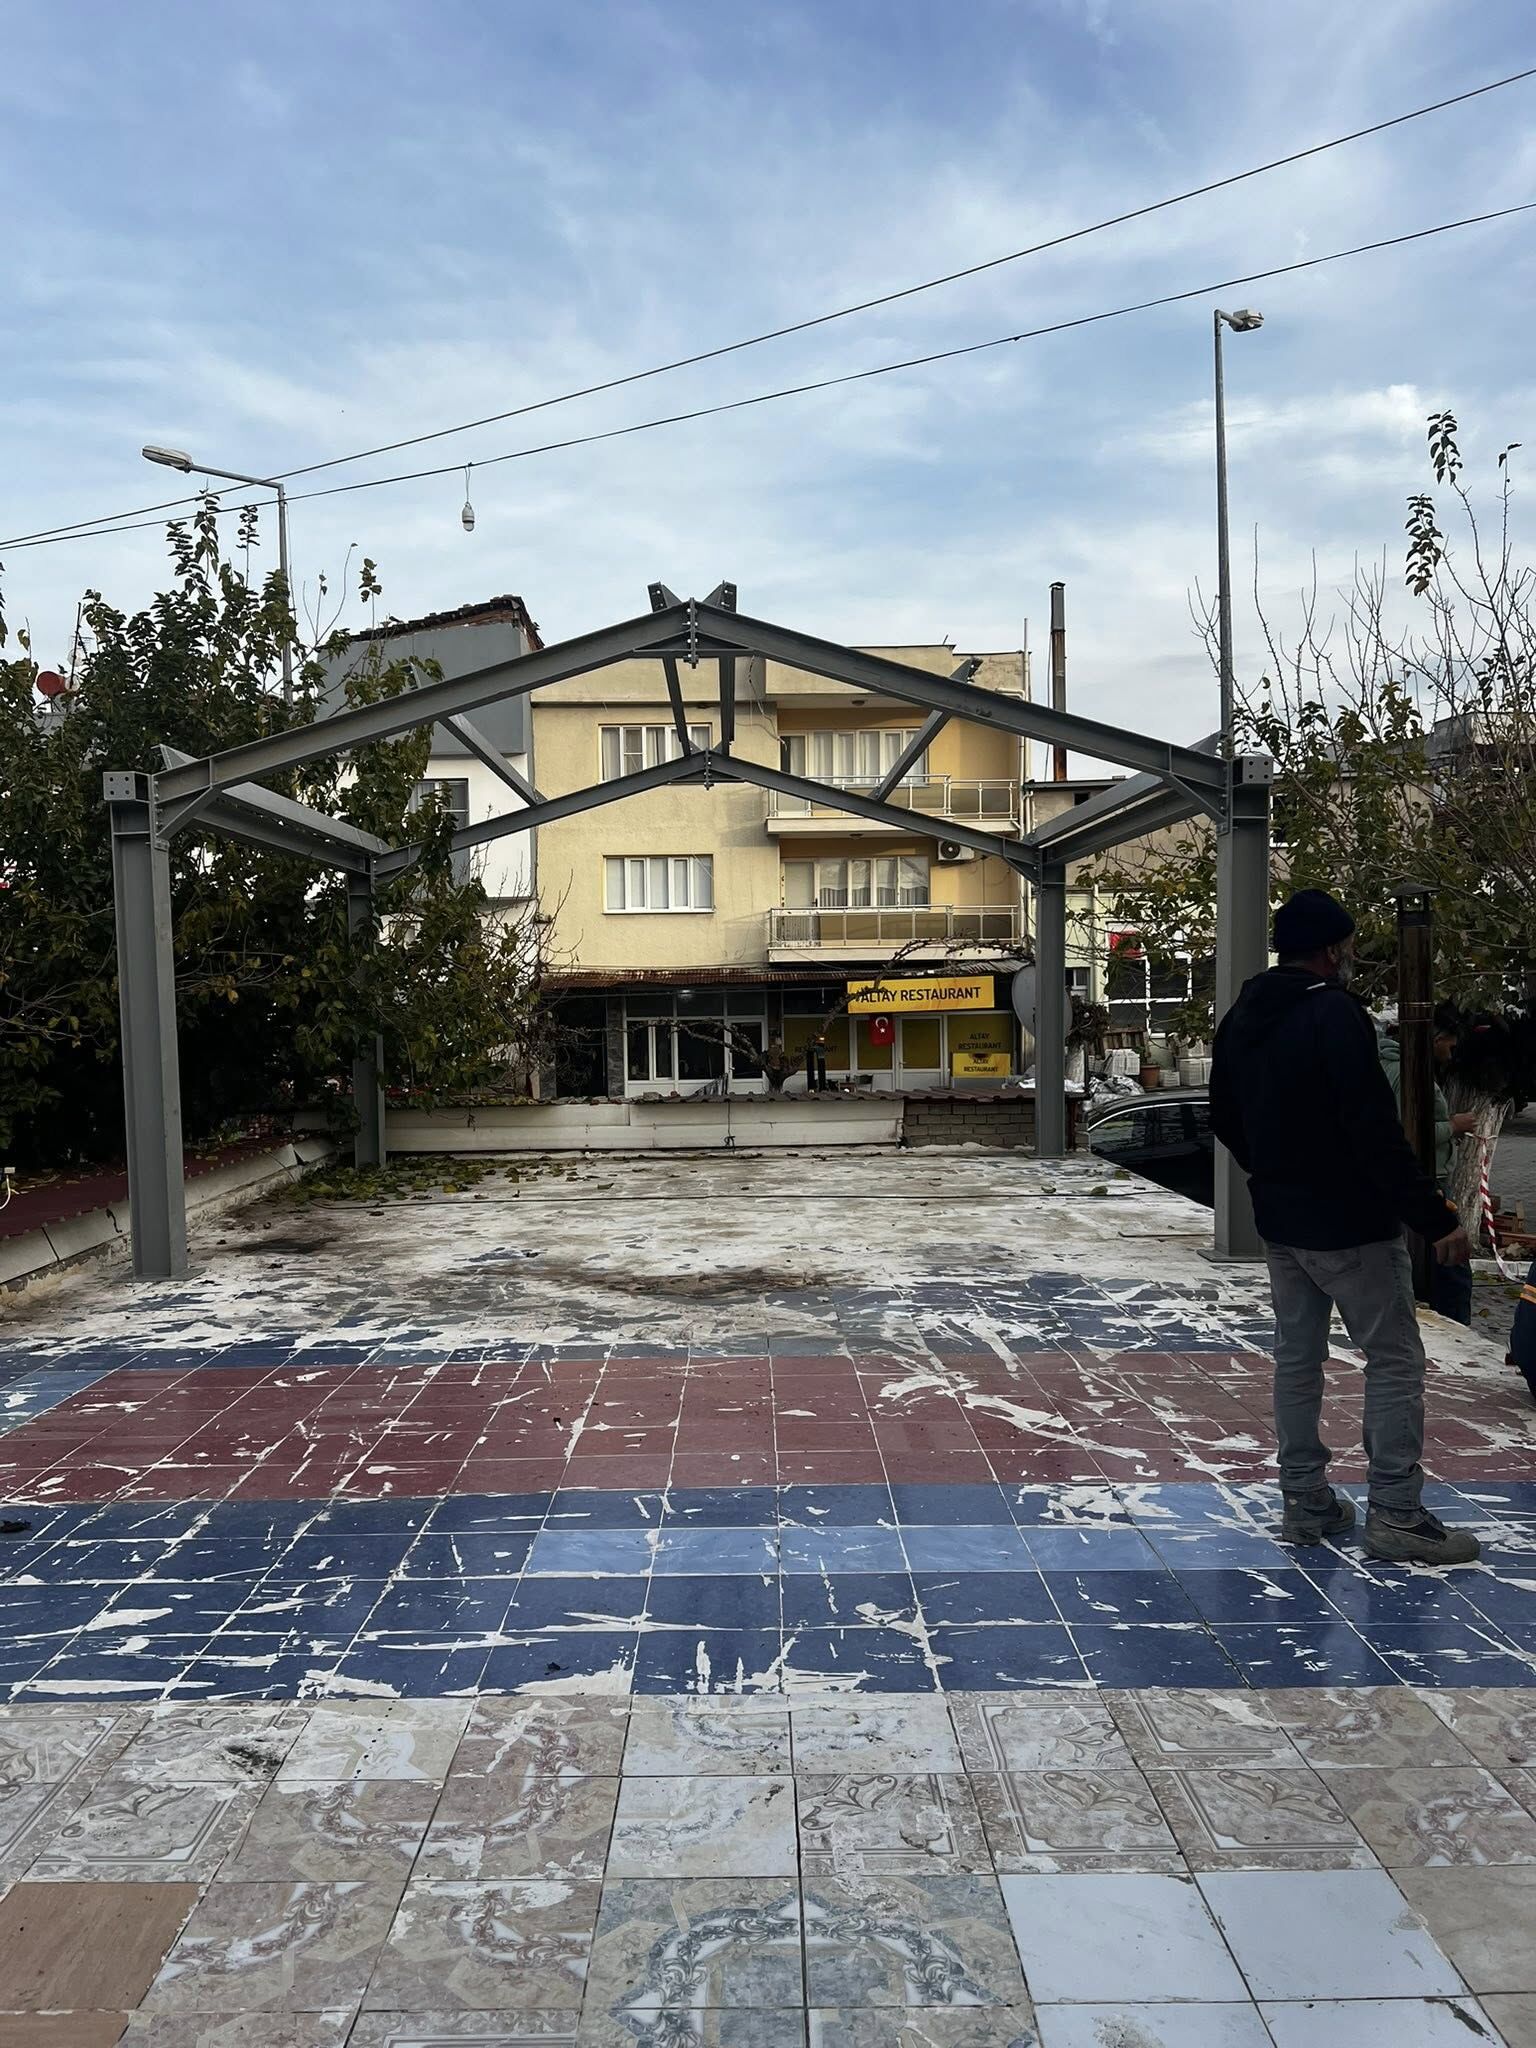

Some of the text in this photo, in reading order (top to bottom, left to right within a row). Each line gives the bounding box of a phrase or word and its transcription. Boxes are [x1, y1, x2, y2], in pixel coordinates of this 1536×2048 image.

[861, 987, 981, 1003] ALTAY RESTAURANT
[969, 1032, 990, 1040] ALTAY
[958, 1042, 1001, 1050] RESTAURANT
